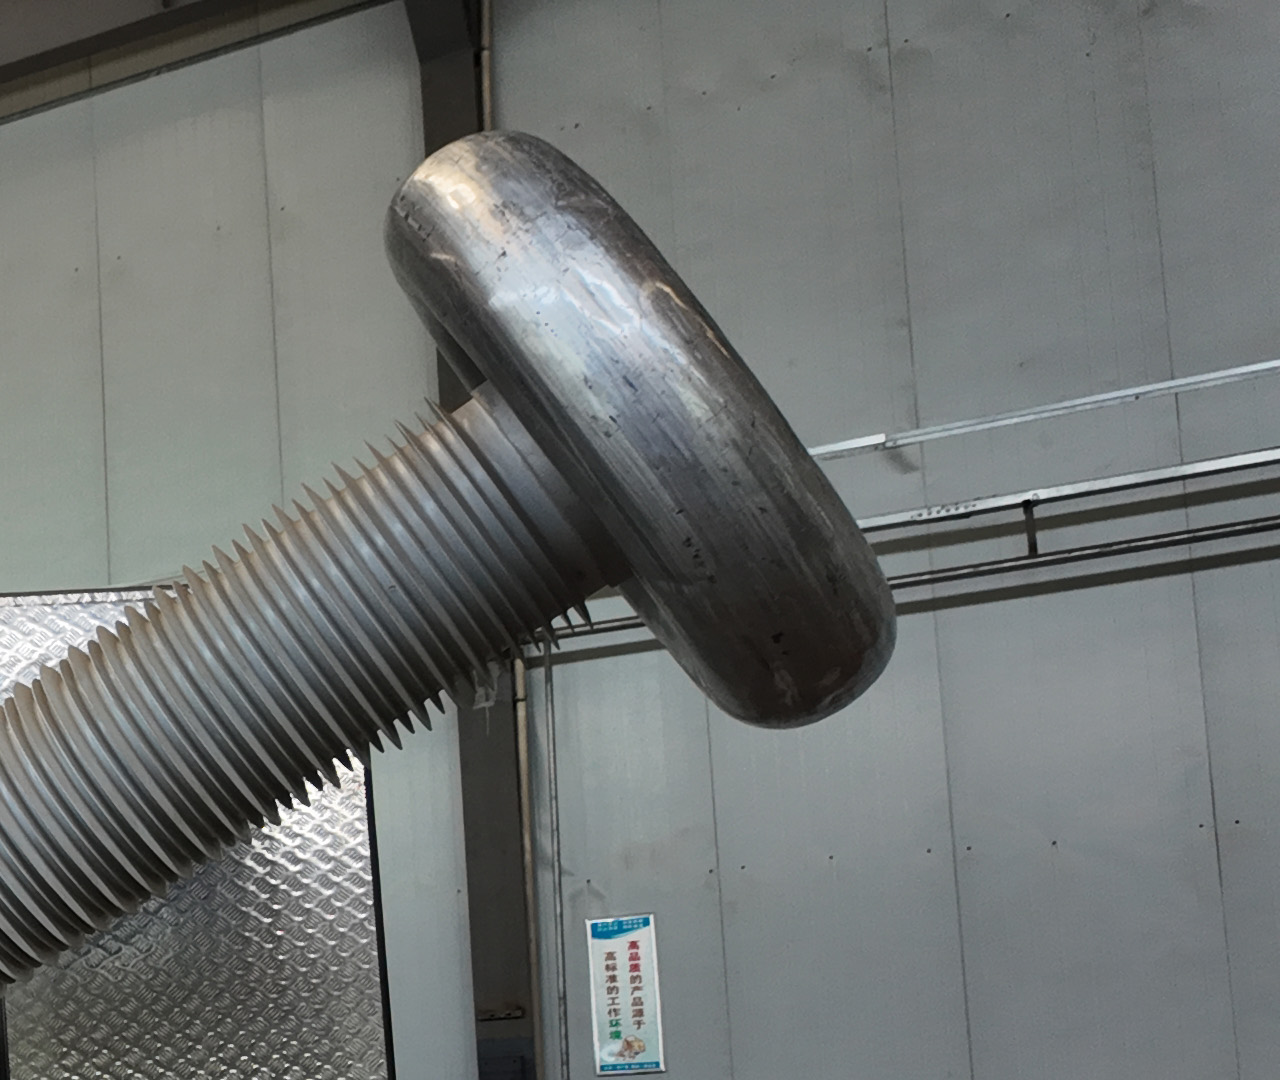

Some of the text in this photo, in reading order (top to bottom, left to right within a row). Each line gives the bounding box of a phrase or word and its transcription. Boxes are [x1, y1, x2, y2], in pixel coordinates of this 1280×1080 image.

[627, 940, 645, 1030] 高品质的产品源于
